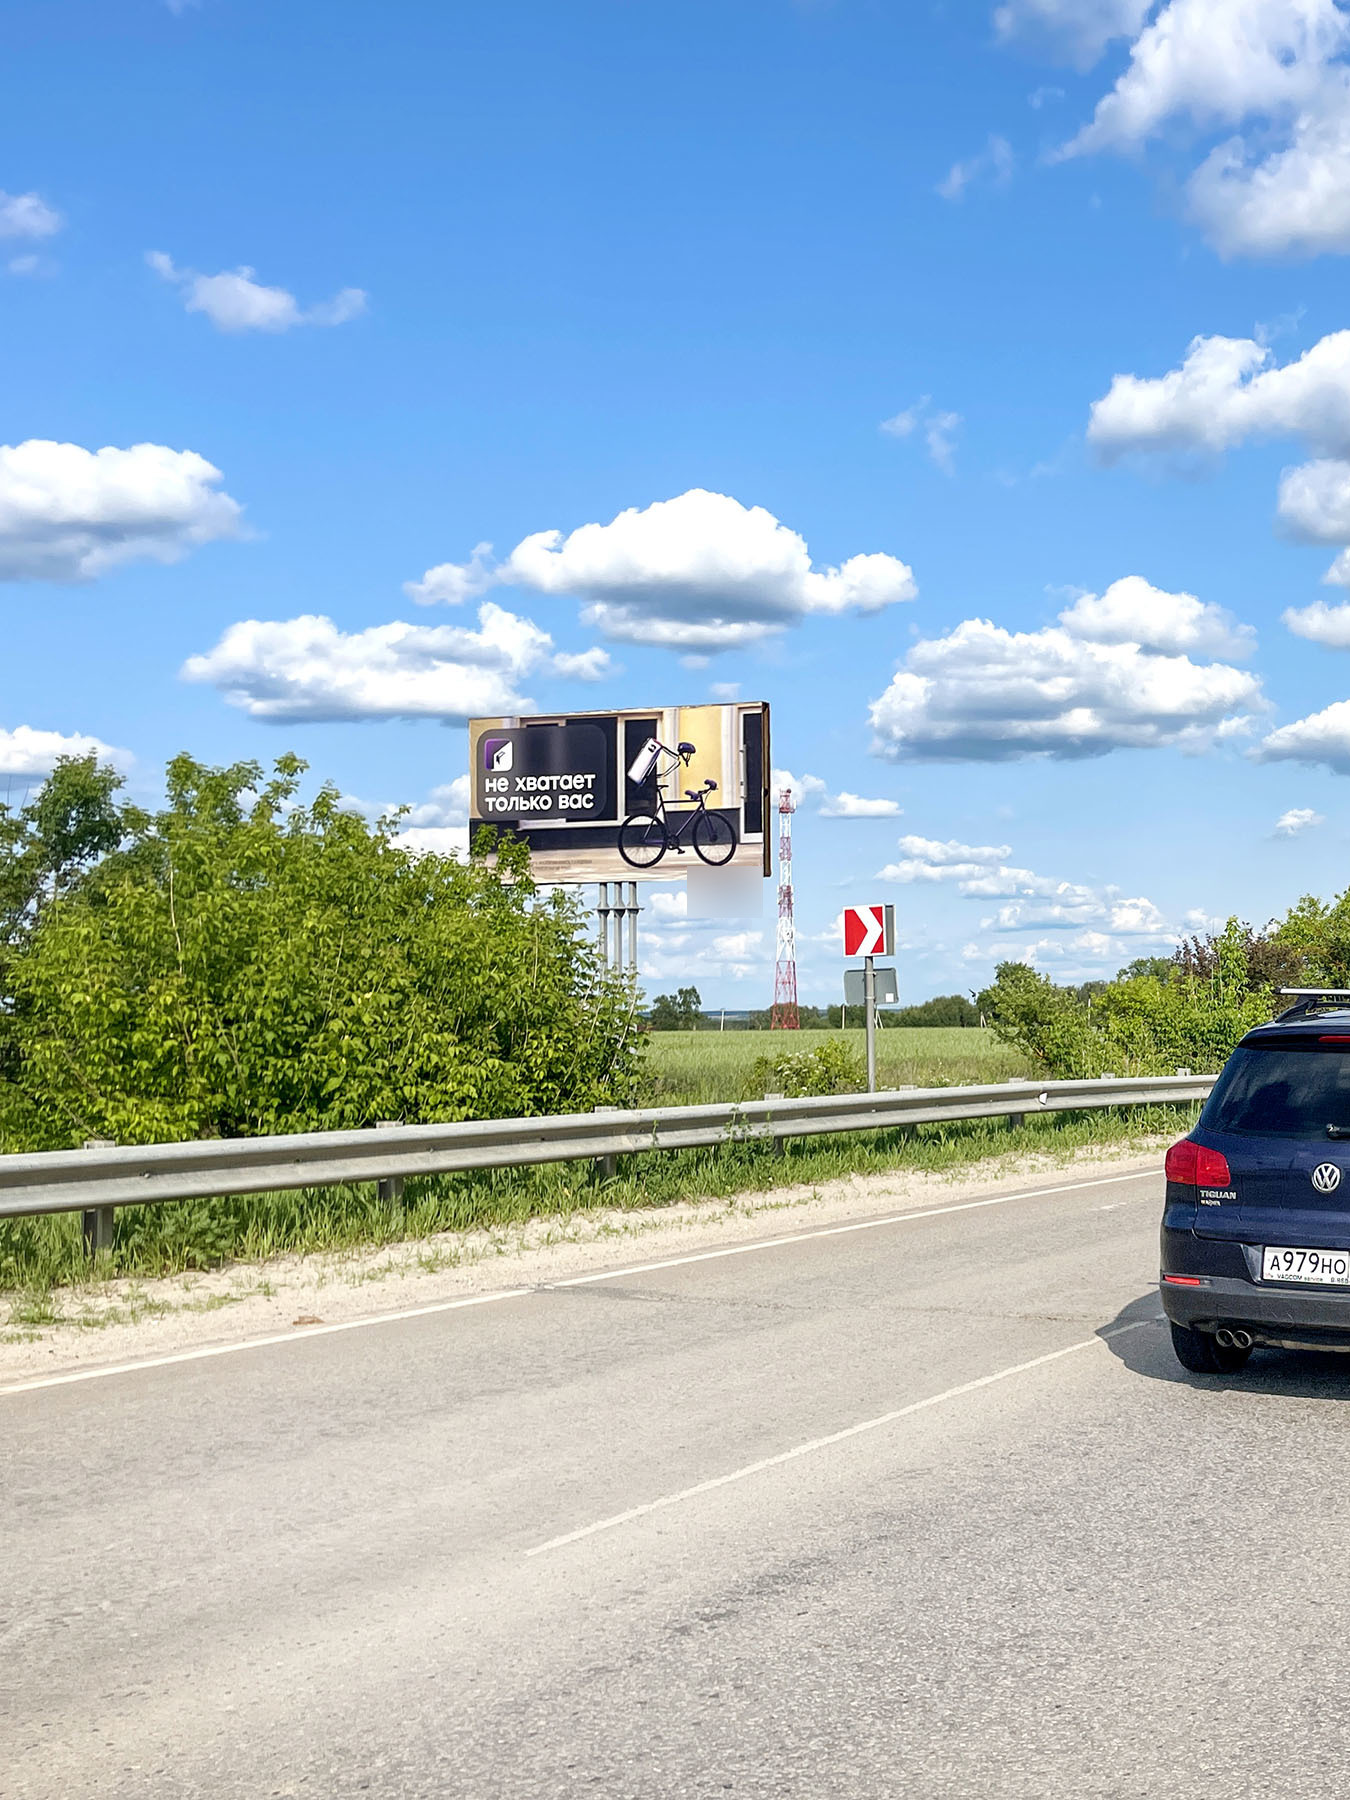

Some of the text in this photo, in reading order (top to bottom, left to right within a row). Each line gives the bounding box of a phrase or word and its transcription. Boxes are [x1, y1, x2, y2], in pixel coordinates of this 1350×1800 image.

[485, 774, 596, 793] не хватает
[485, 793, 594, 812] только вас
[1200, 1190, 1237, 1200] TIGUAN
